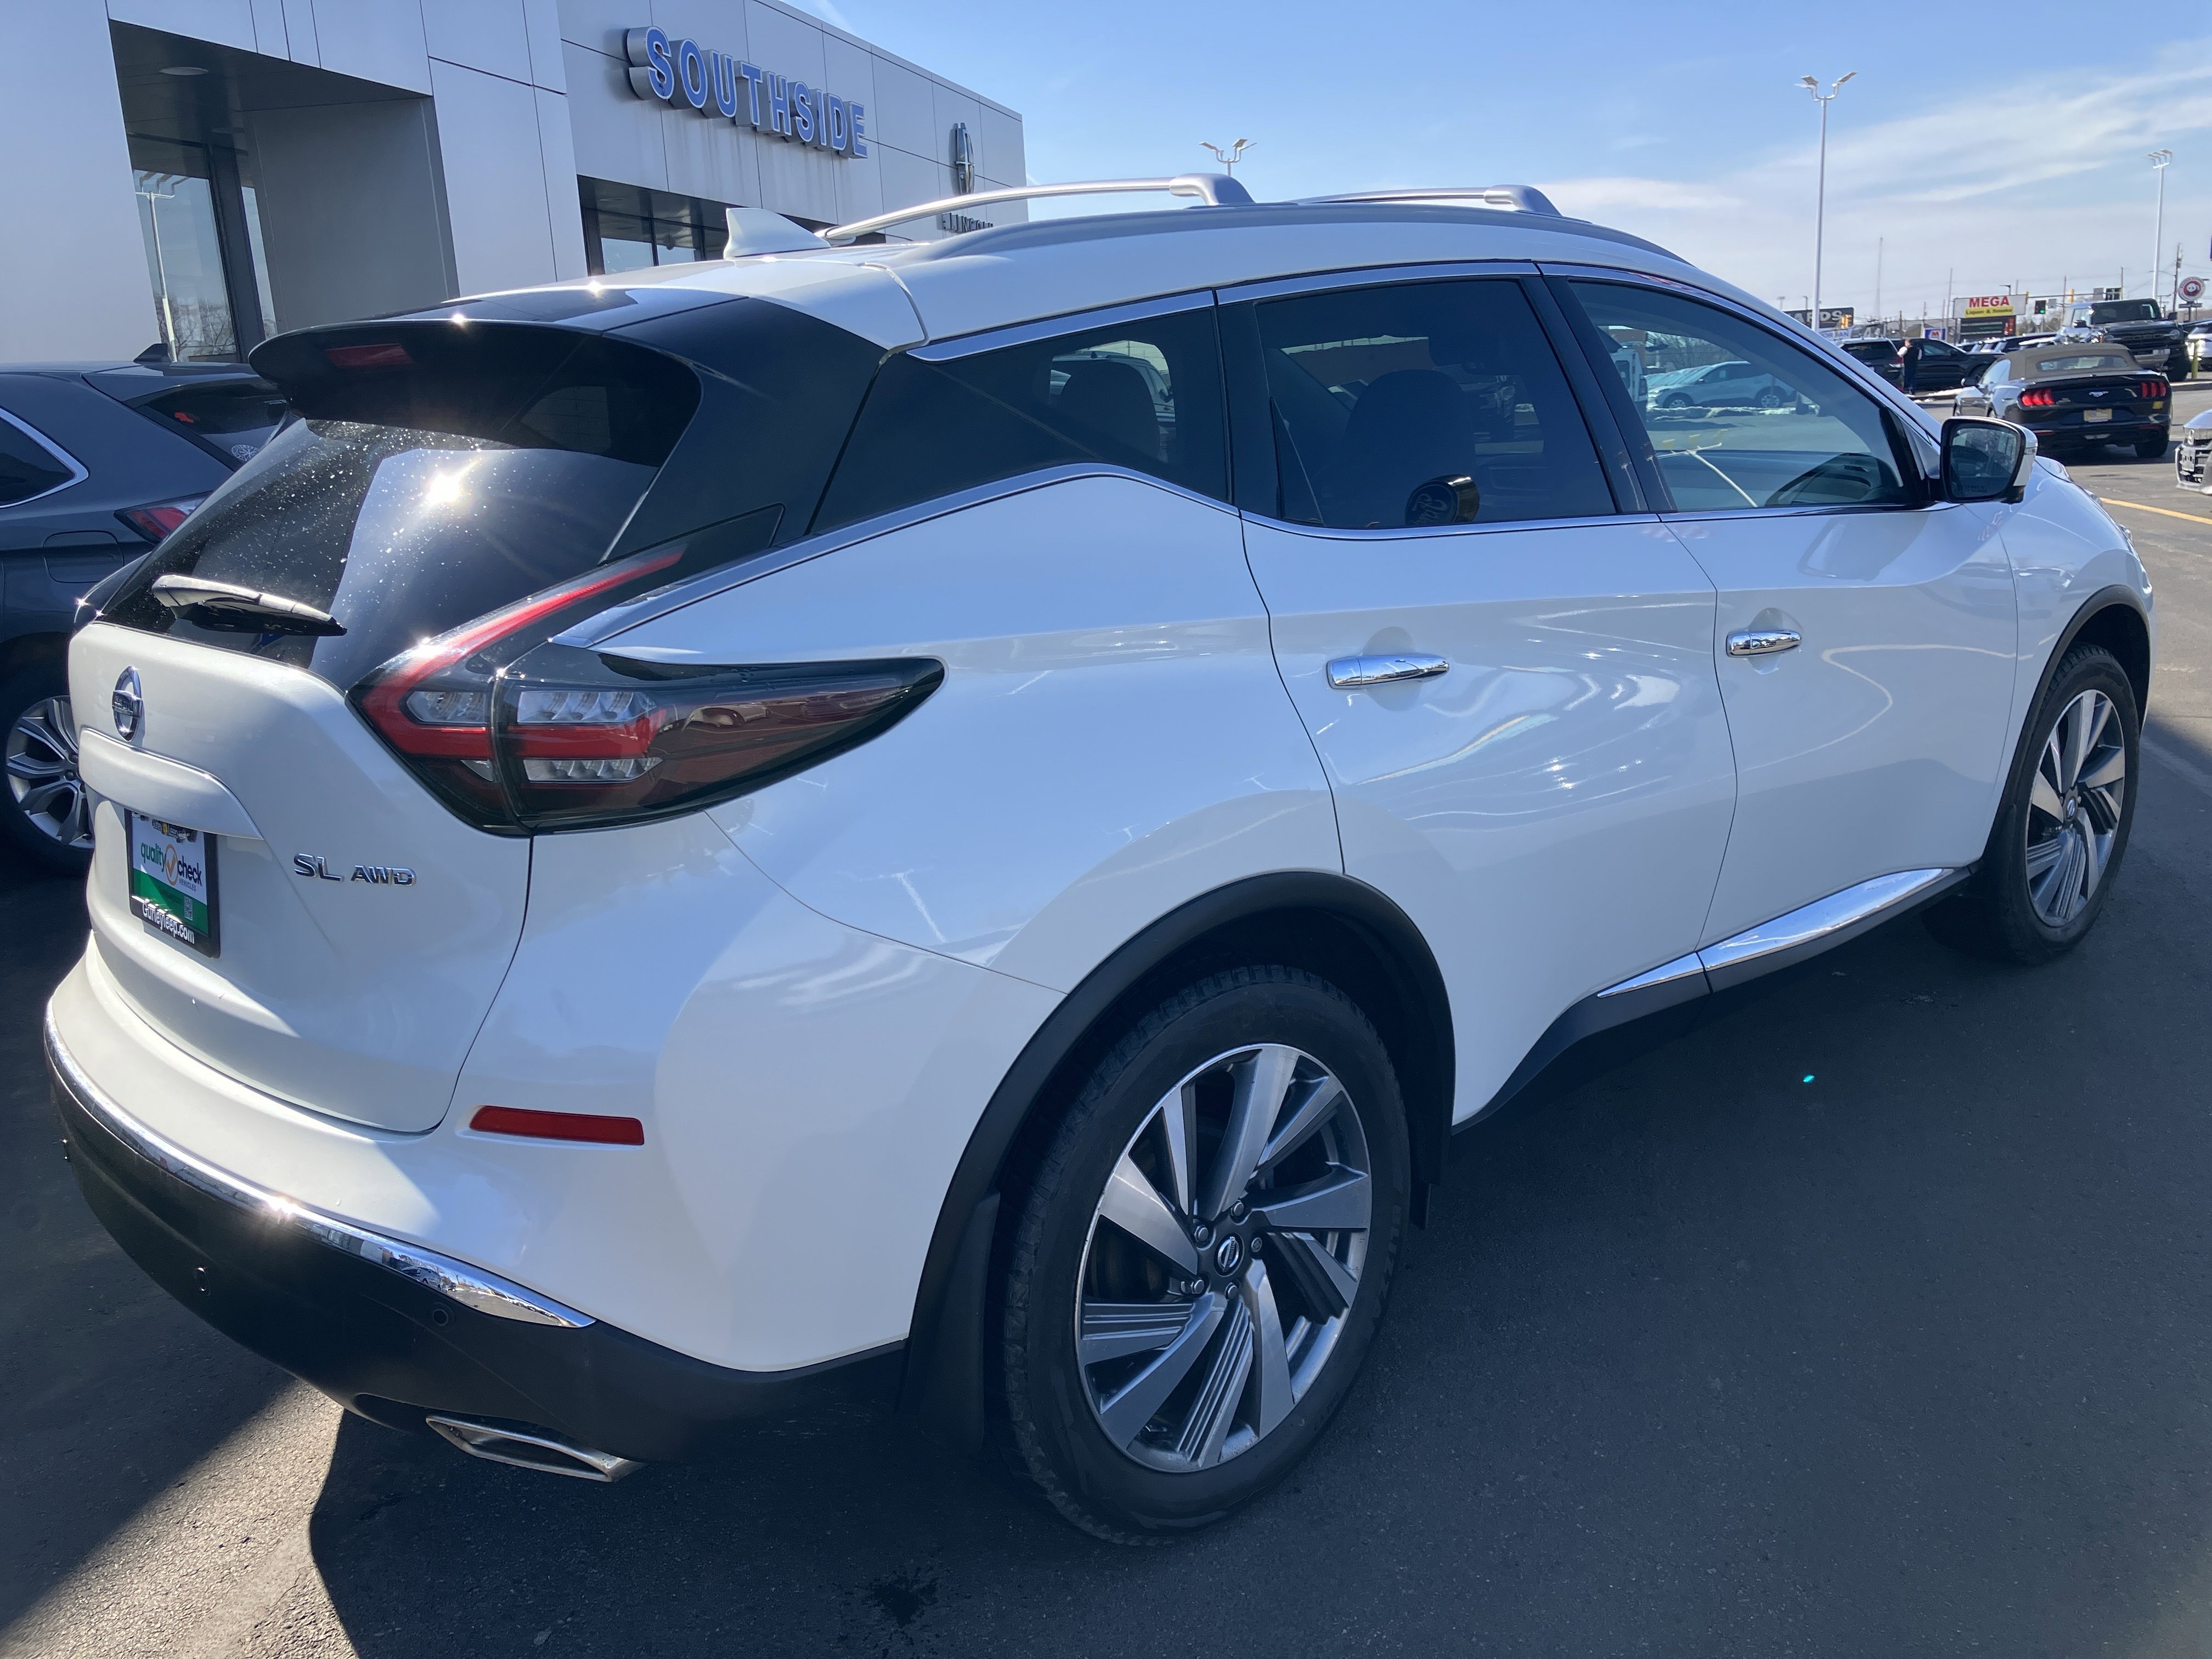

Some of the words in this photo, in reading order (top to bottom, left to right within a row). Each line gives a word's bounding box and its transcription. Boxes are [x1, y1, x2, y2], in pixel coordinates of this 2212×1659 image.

[627, 26, 868, 159] SOUTHSIDE
[1969, 296, 2010, 308] MEGA
[140, 842, 165, 873] quality
[177, 855, 202, 887] check
[294, 853, 345, 882] SL
[351, 865, 416, 887] AWD
[179, 878, 196, 892] VEHICLES
